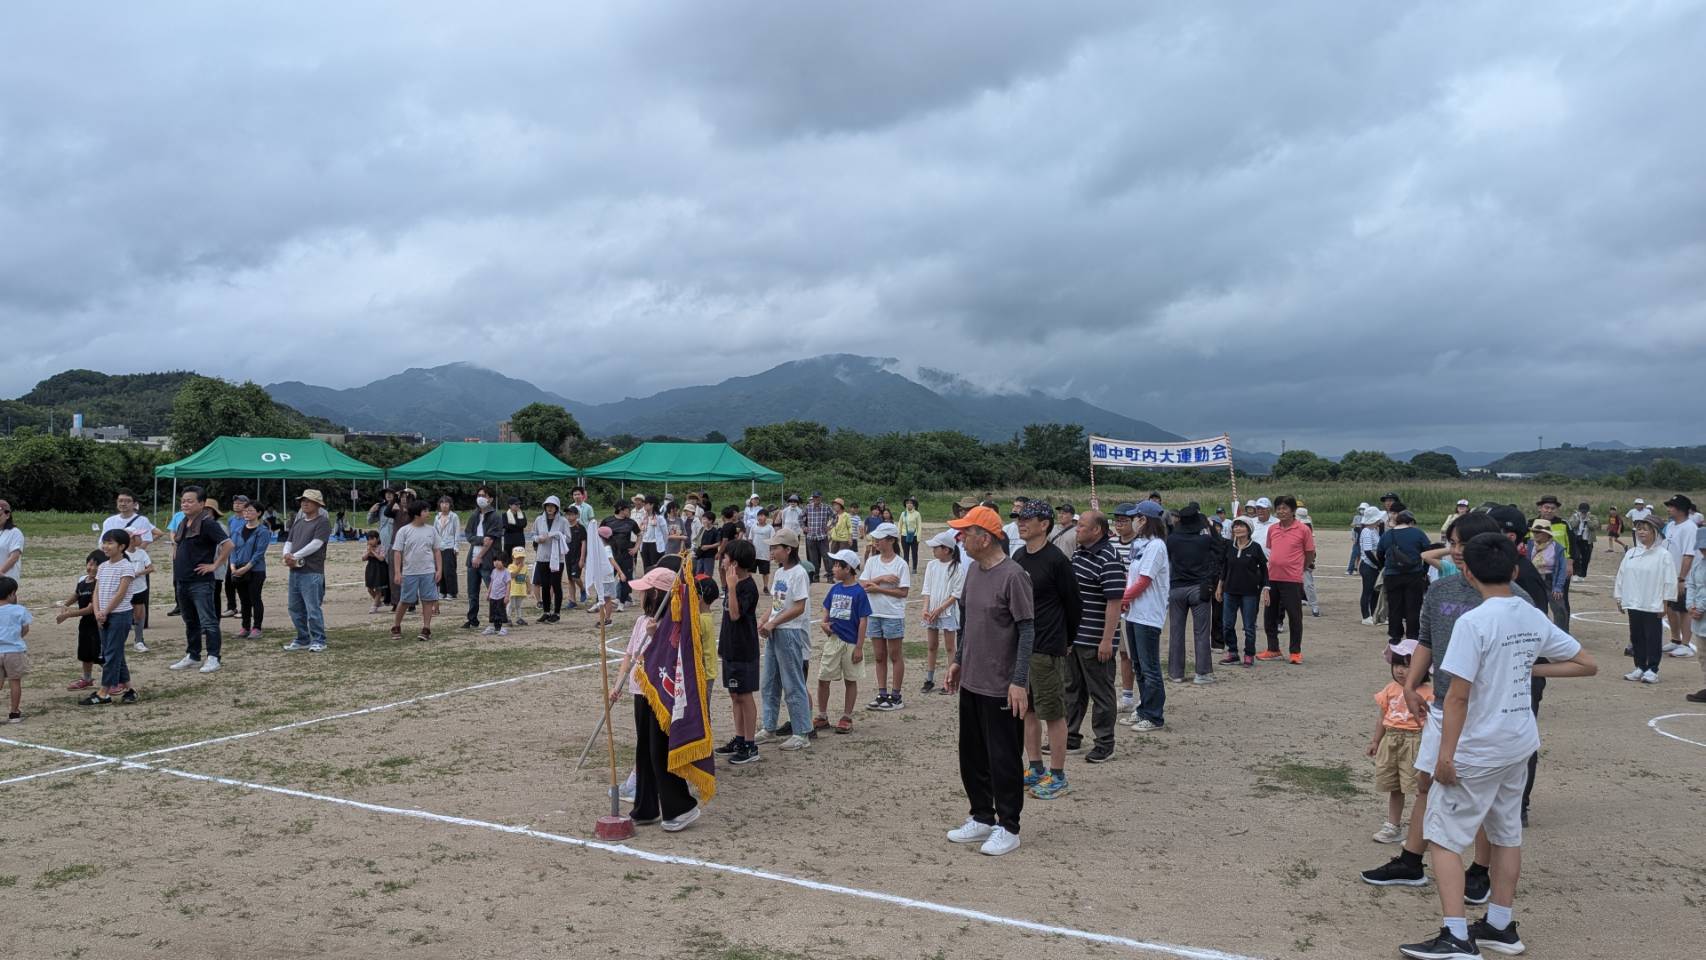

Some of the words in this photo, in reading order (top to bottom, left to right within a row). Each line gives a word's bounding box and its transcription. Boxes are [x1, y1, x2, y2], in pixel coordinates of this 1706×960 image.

[1092, 442, 1227, 463] 畑中町内大運動会
